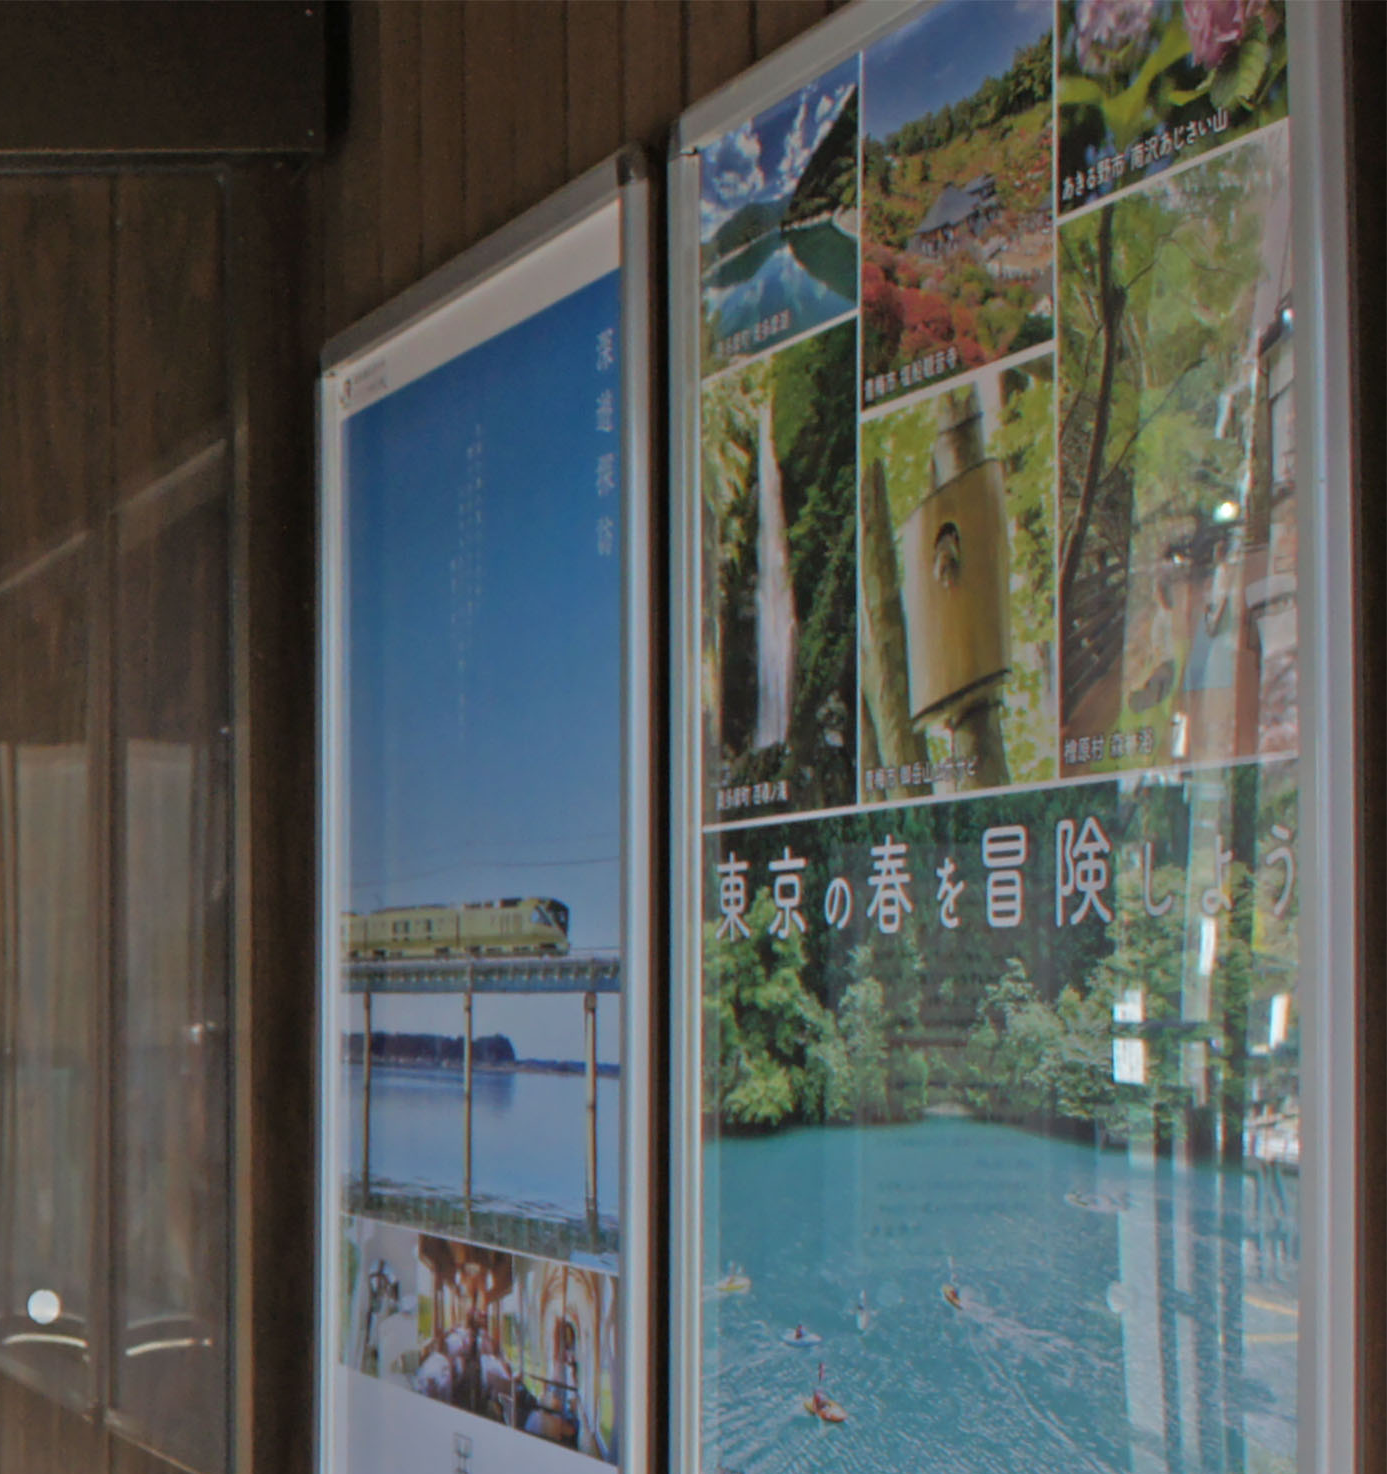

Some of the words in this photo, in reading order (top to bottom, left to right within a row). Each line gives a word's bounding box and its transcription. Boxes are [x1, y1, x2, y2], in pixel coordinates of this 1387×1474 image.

[713, 815, 1298, 942] 東京の春を冒険しよう
